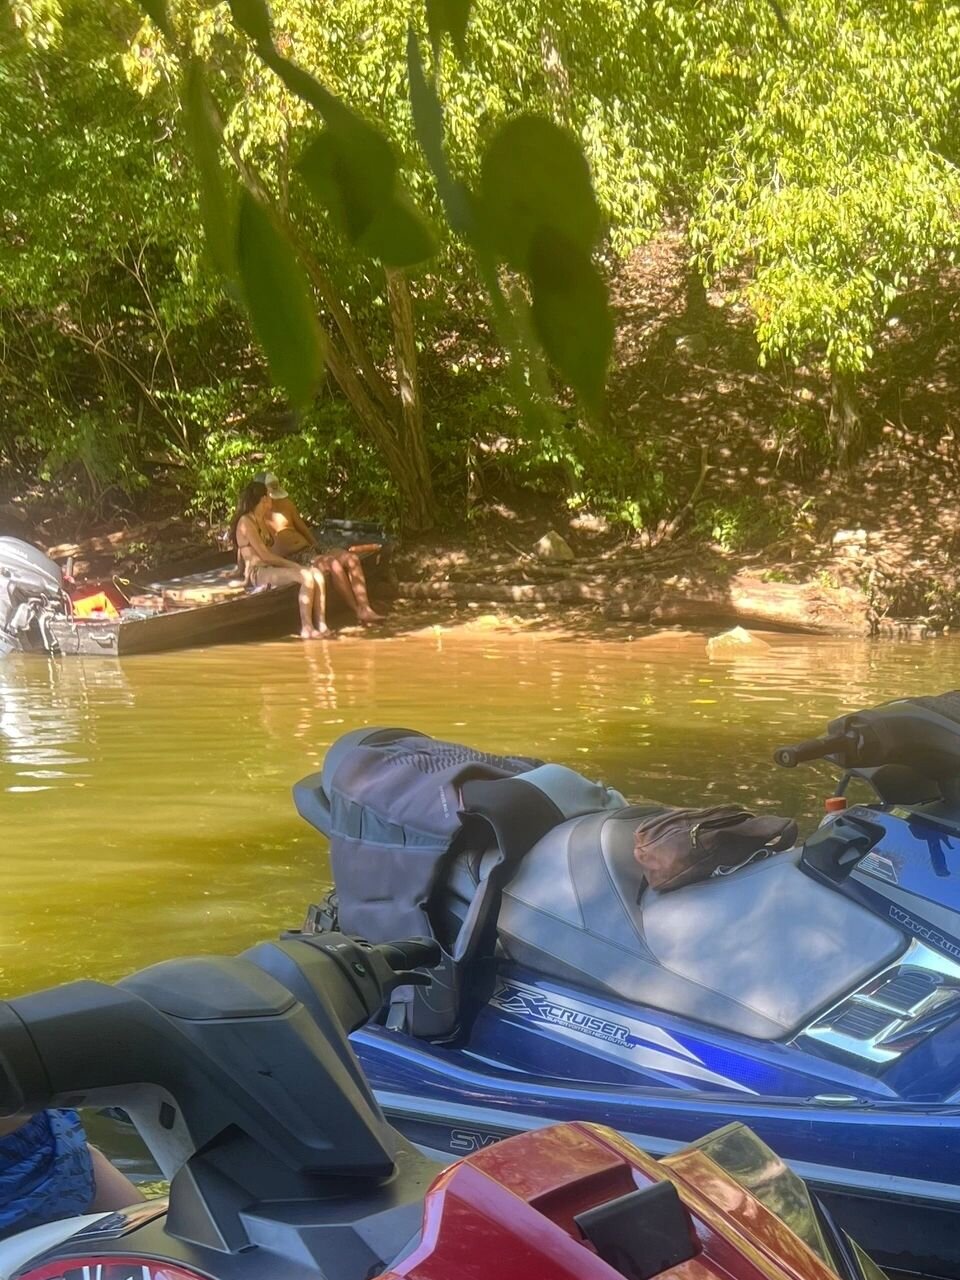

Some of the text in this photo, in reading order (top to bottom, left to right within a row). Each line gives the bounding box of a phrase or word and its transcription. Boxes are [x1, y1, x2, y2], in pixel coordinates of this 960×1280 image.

[493, 983, 630, 1040] FX CRUISER
[608, 1035, 636, 1048] OUTPUT
